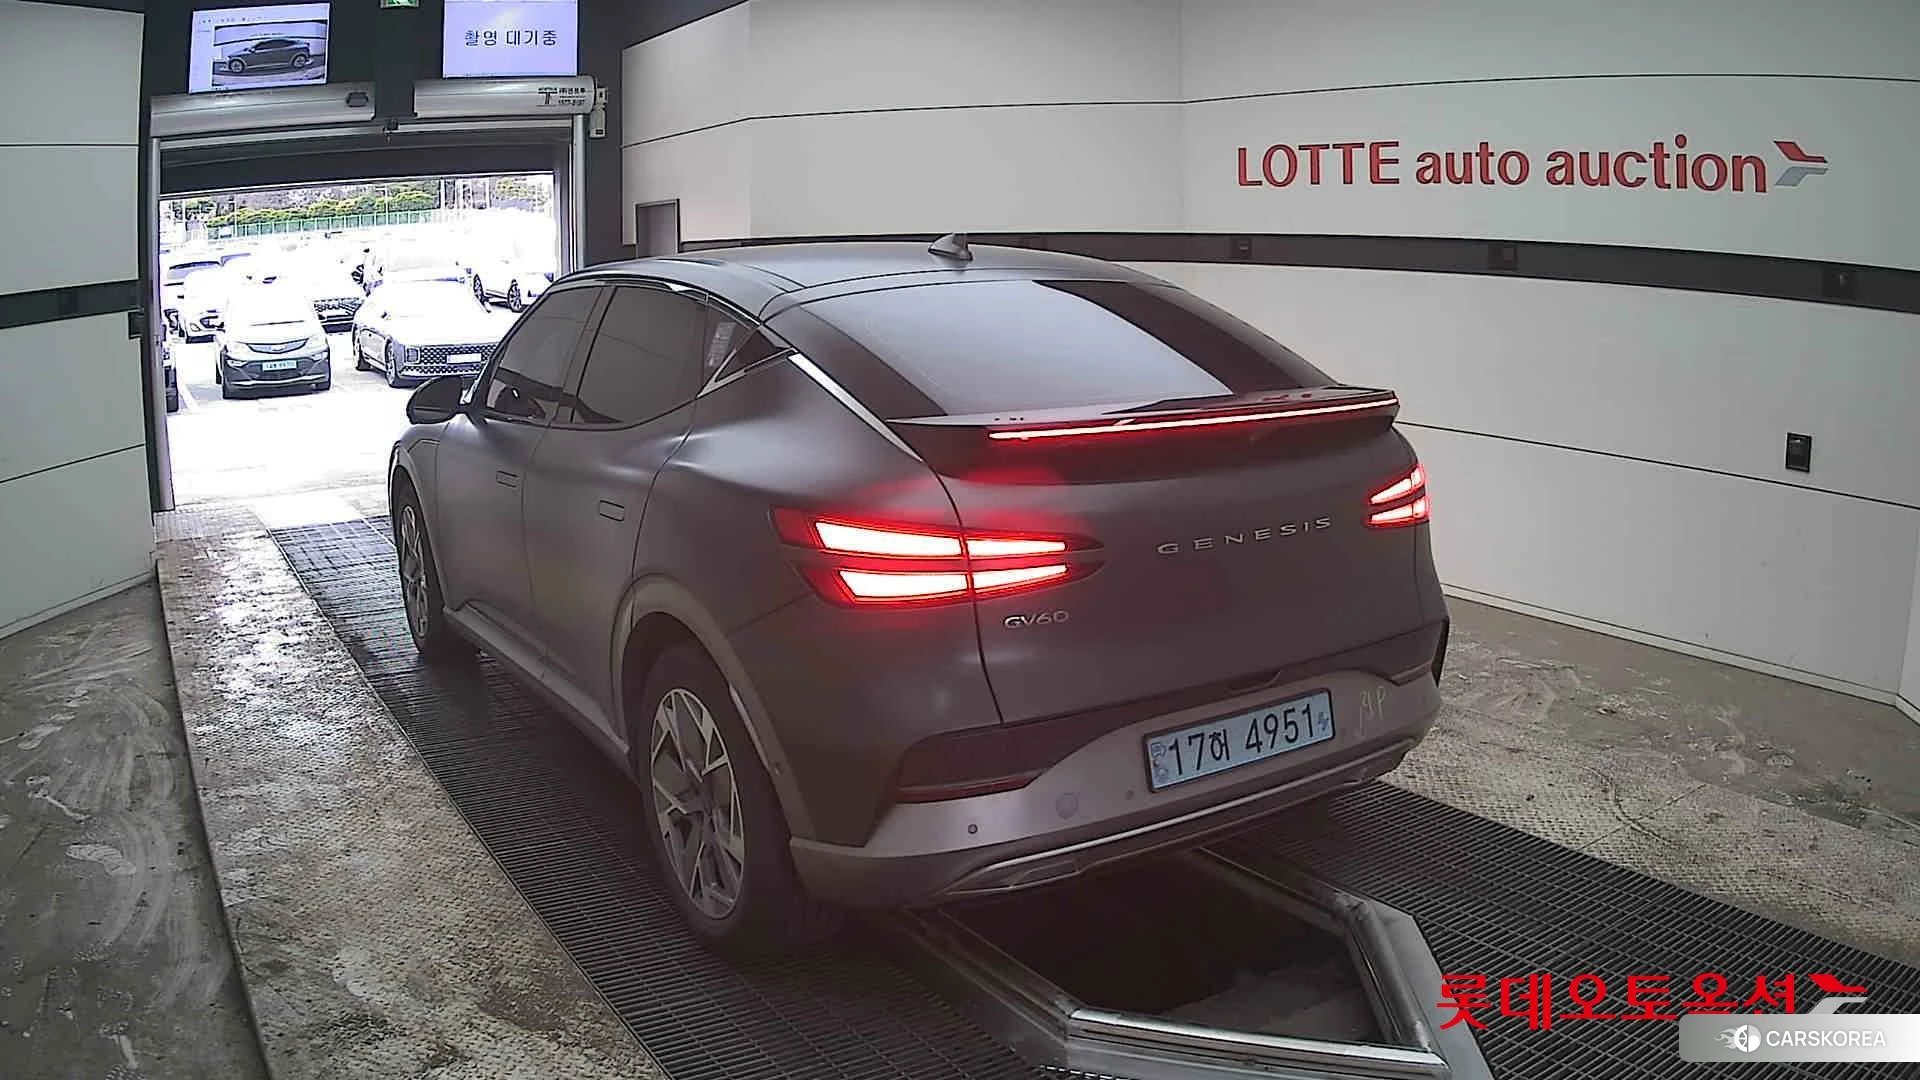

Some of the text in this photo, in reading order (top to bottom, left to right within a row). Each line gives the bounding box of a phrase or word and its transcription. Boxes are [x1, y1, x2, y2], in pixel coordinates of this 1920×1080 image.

[464, 29, 498, 47] 촬영
[1238, 133, 1767, 193] LOTTE auto auction
[1157, 516, 1332, 555] GENESIS
[1004, 609, 1070, 629] GV60
[1168, 728, 1231, 776] 17허
[1245, 703, 1314, 753] 4951
